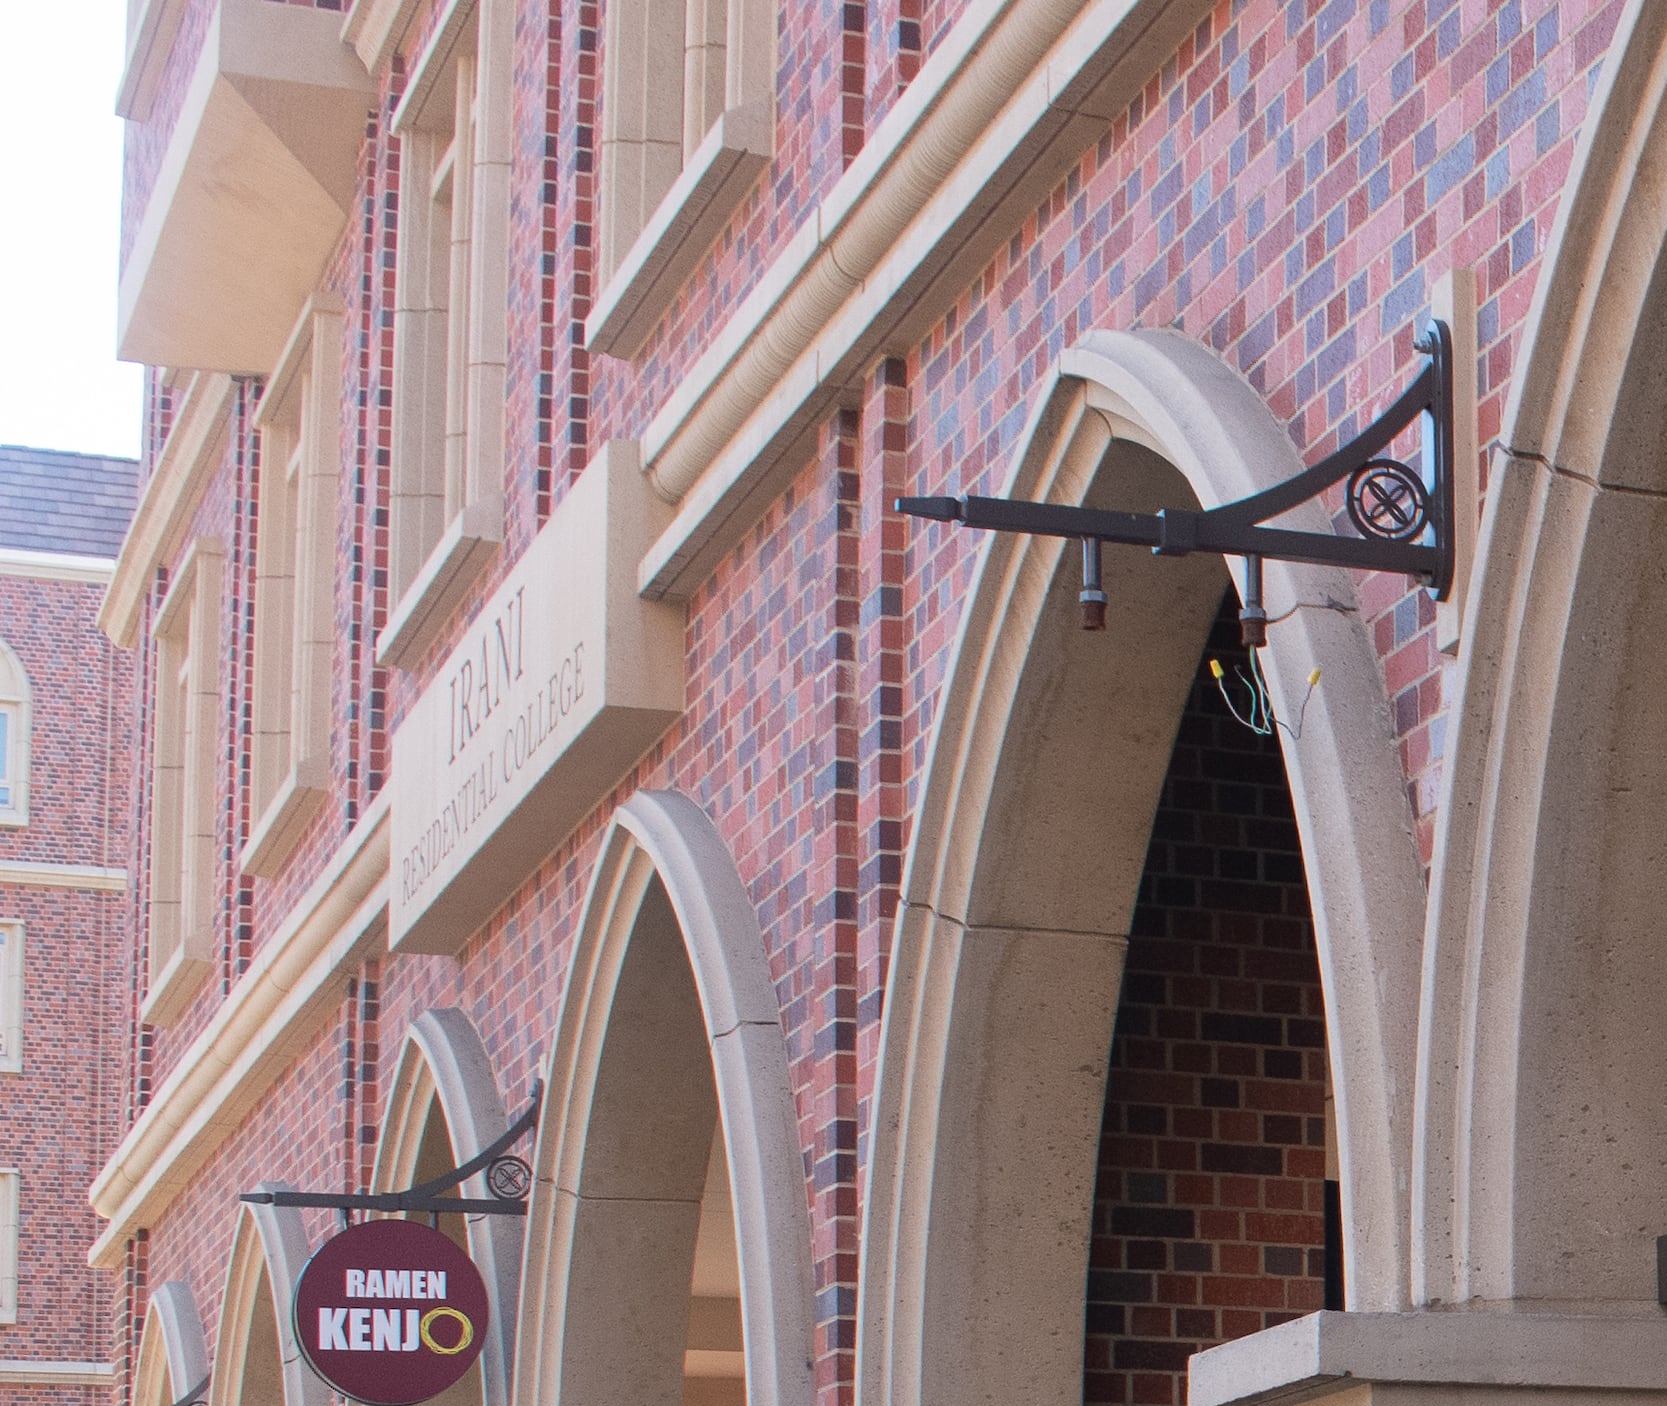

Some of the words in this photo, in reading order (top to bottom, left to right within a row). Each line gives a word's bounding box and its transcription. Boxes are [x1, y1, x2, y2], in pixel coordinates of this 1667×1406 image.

[449, 585, 525, 765] IRANI
[402, 751, 497, 906] RESIDENTIAL
[503, 641, 585, 784] COLLEGE
[318, 1306, 474, 1355] KENJO
[346, 1269, 447, 1299] RAMEN
